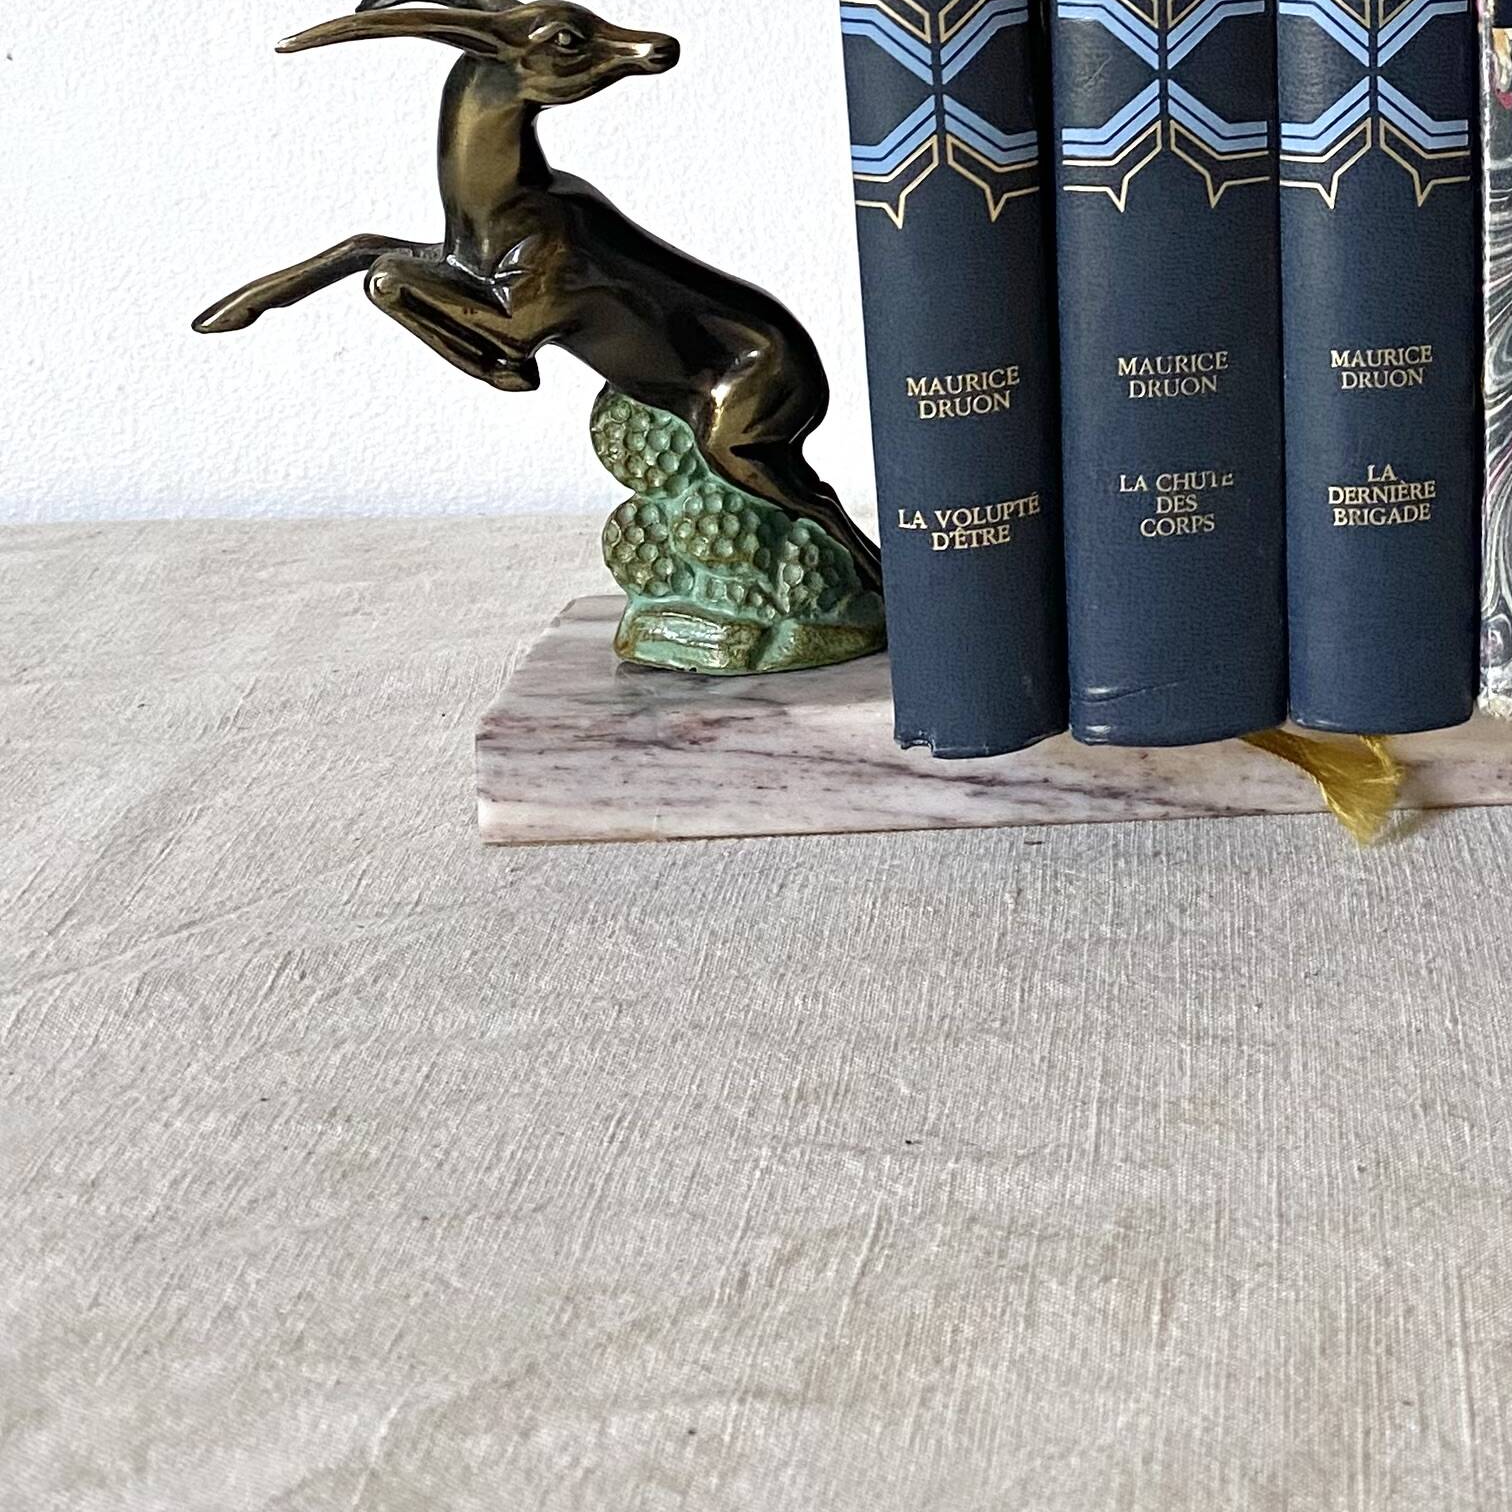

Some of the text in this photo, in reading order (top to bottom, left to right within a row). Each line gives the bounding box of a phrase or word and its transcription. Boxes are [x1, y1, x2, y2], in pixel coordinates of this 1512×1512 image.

[1117, 351, 1230, 377] MAURICE
[1330, 345, 1433, 368] MAURICE
[906, 365, 1021, 397] MAURICE
[1128, 375, 1219, 399] DRUON
[1341, 368, 1424, 389] DRUON
[919, 390, 1012, 419] DRUON
[1119, 474, 1149, 493] LA
[1367, 464, 1397, 481] LA
[1155, 494, 1198, 515] DES
[1327, 480, 1436, 505] DERNIÈRE
[898, 491, 1041, 530] LA VOLUPTÉ
[1332, 503, 1431, 526] BRIGADE
[1140, 513, 1216, 538] CORPS
[931, 524, 1012, 552] D'ÊTRE
